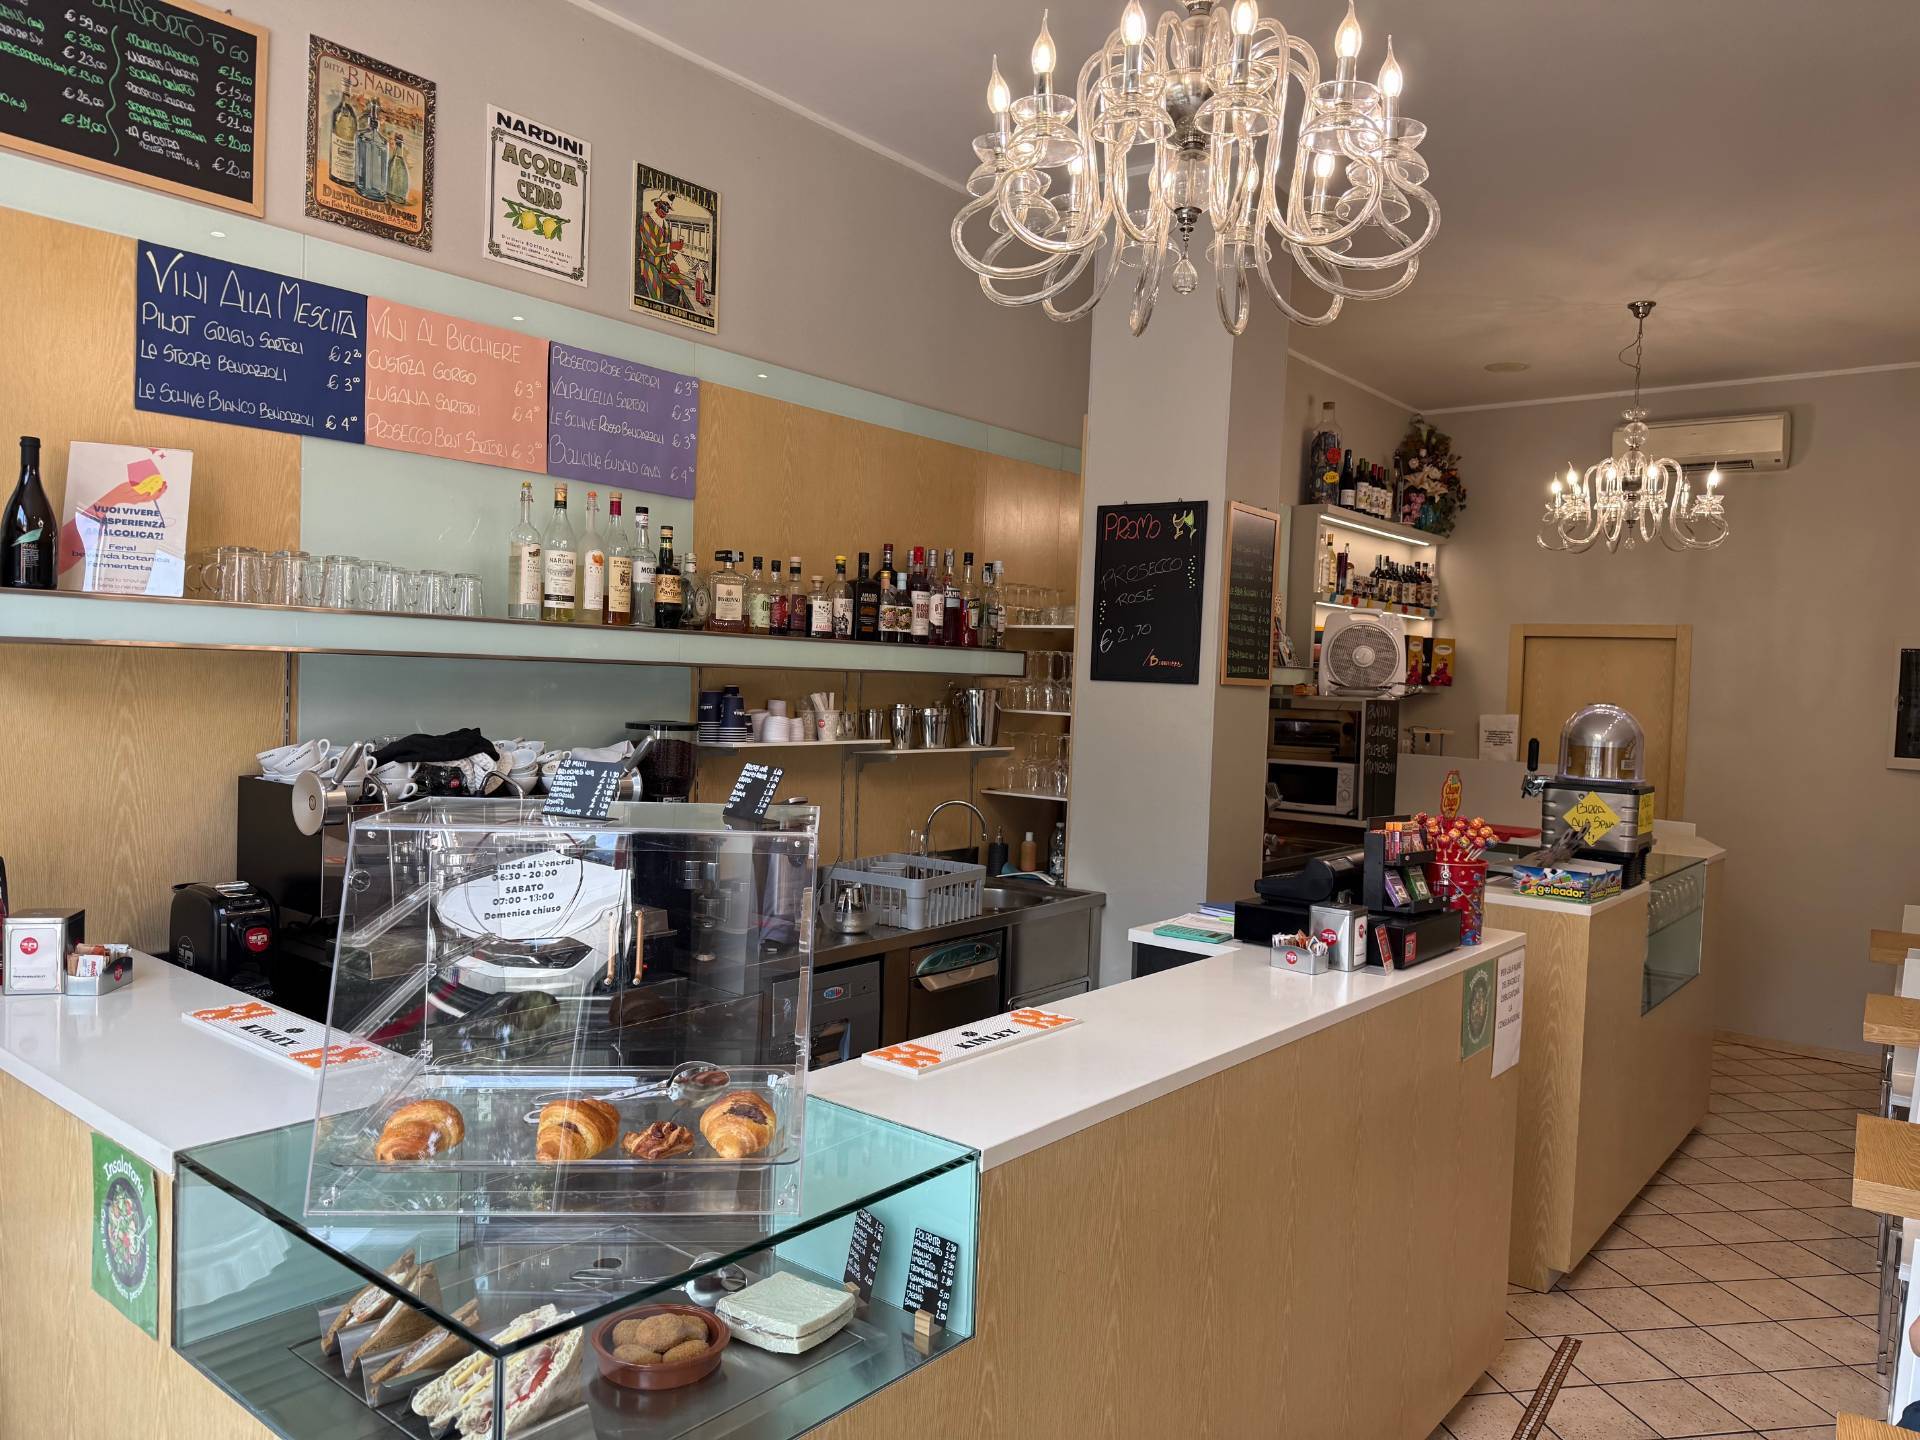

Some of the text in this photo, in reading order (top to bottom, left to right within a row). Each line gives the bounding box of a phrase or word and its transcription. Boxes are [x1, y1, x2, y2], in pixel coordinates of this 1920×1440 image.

[324, 60, 345, 75] DITTA
[364, 71, 420, 107] NARDINI
[496, 111, 583, 156] NARDINI
[501, 142, 578, 187] ACQUA
[520, 170, 561, 190] DI TUTTO
[516, 178, 563, 210] CEDRO
[146, 250, 358, 339] VINI ALLA MESCITA
[417, 318, 438, 347] AL
[446, 323, 523, 365] BICCHIERE
[367, 349, 477, 385] CUSTOZA GORGO
[552, 345, 599, 374] PROSECCO
[208, 390, 256, 416] BIANCO
[367, 383, 481, 417] LUGANA SARTORI
[551, 376, 649, 413] VALPOLICELLA SARTORI
[366, 412, 432, 445] PROSECCO
[94, 505, 160, 517] VUOI VIVERE
[1104, 512, 1162, 541] PROMO
[109, 543, 137, 552] Feral
[1101, 557, 1183, 591] PROSECCO
[1100, 628, 1115, 654] €
[1576, 803, 1606, 814] BIRRA
[528, 860, 537, 869] al
[529, 868, 558, 879] 20:00
[492, 892, 555, 906] 07:00 13:00
[505, 883, 544, 894] SABATO
[1537, 885, 1585, 898] goleador
[484, 904, 561, 920] Domenica chiuso
[239, 1023, 299, 1048] KINLEY
[954, 1028, 1021, 1050] KINLEY
[103, 1154, 144, 1199] Insalatona
